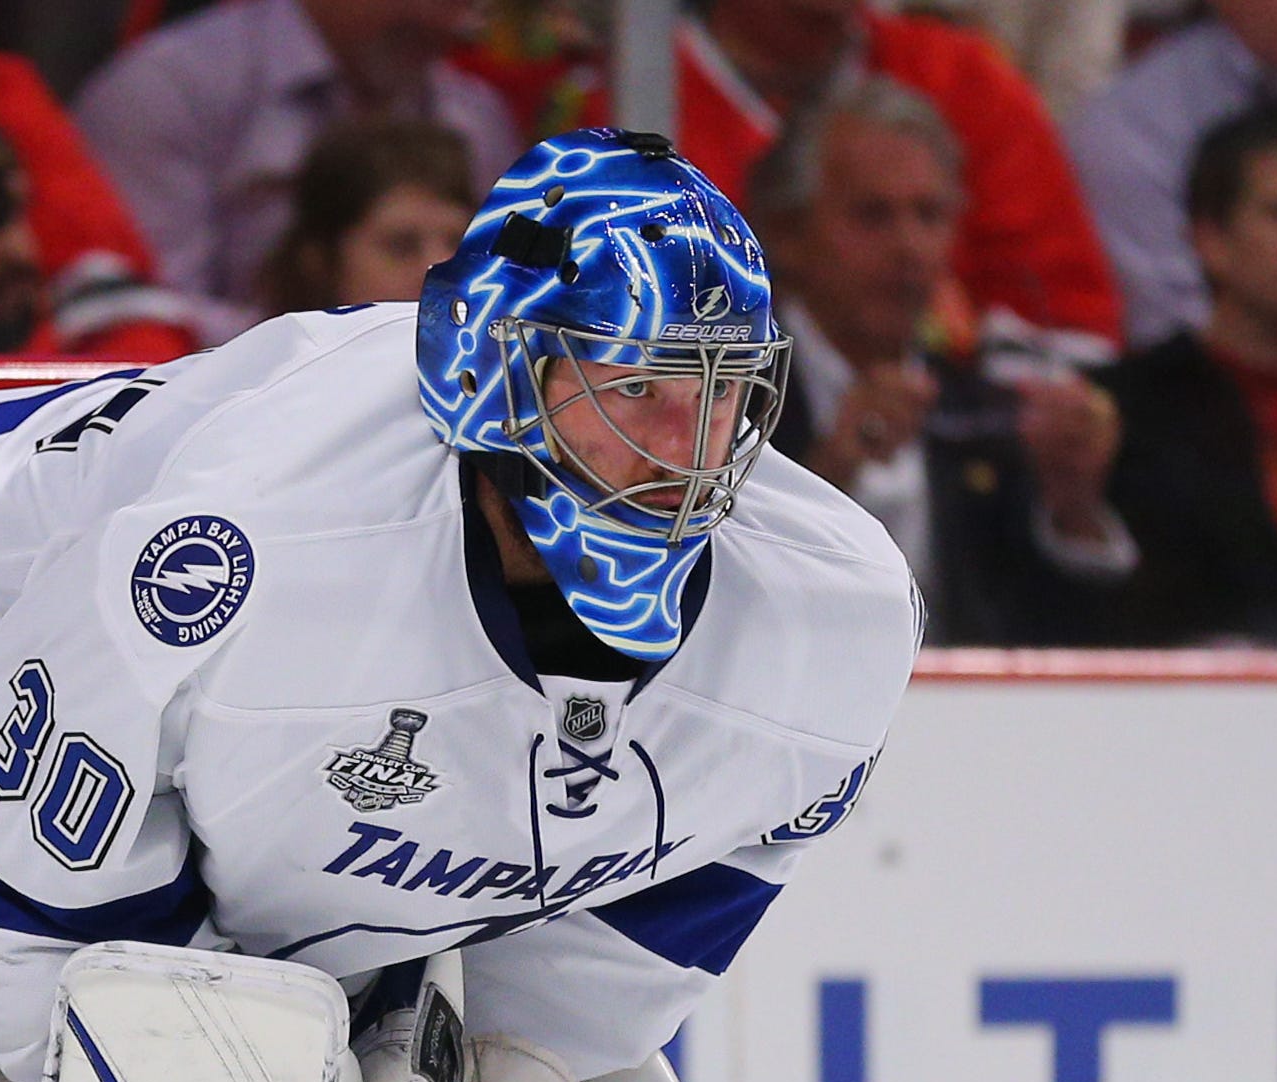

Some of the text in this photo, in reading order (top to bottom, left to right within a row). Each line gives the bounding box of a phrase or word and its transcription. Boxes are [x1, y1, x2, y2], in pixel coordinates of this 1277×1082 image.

[658, 324, 753, 342] BAUER
[140, 519, 248, 643] TAMPA BAY LIGHTNING
[136, 600, 152, 625] CLUB
[140, 587, 163, 624] HOCKEY
[571, 708, 599, 731] NHL
[330, 755, 438, 792] FINAL
[352, 750, 403, 769] STANLEY
[322, 821, 696, 901] TAMPA BAY
